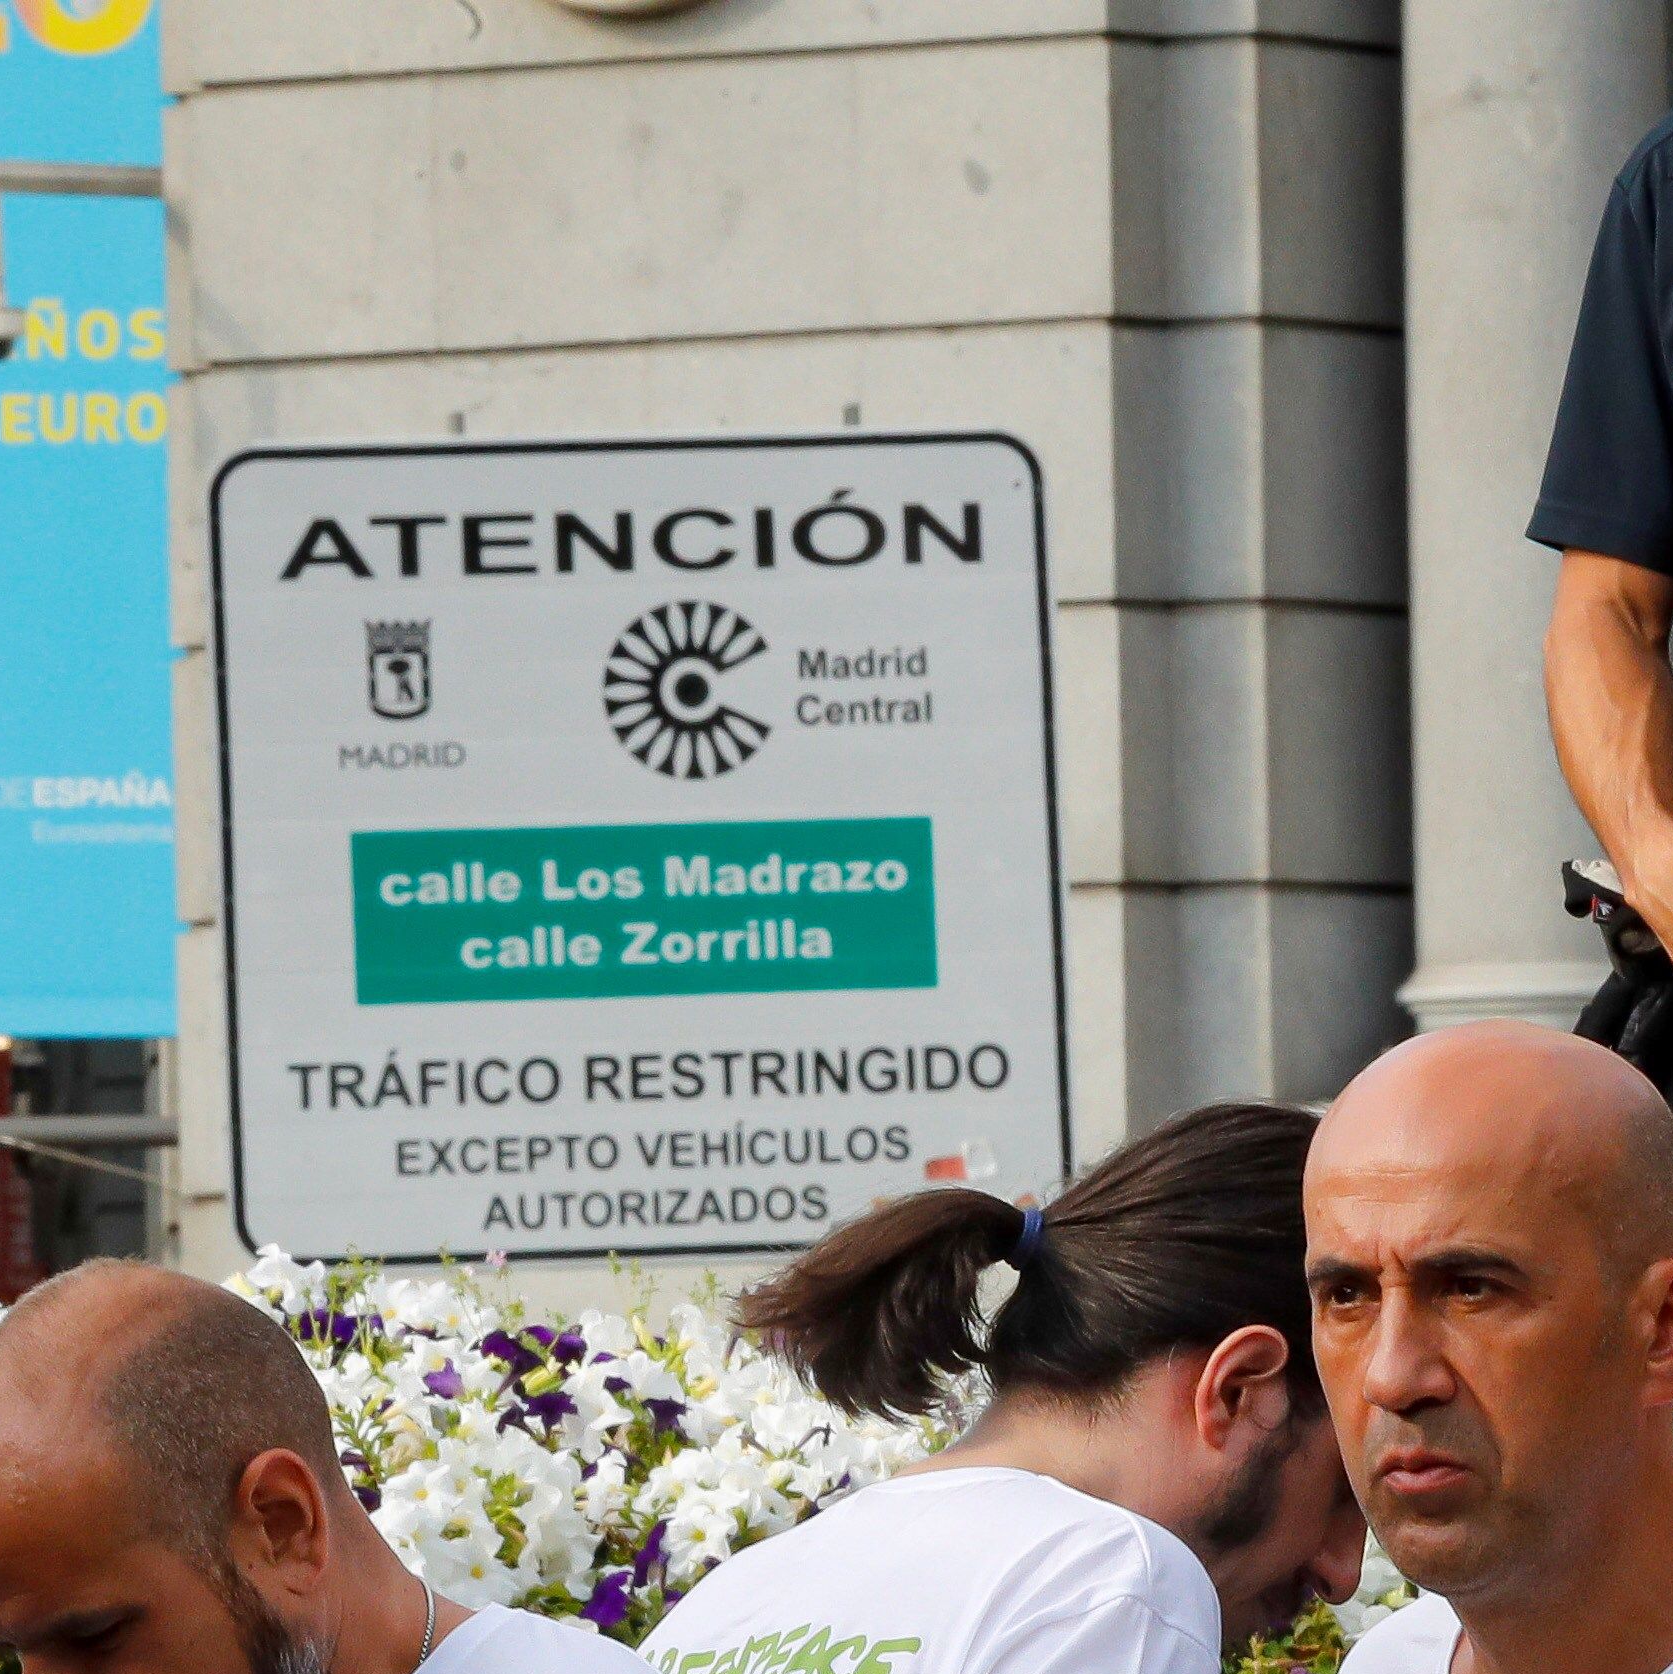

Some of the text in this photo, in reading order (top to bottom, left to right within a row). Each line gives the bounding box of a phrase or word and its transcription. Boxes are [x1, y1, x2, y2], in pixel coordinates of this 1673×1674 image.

[0, 391, 169, 444] EURO
[280, 487, 982, 580] ATENCIÓN
[797, 647, 928, 679] Madrid
[796, 692, 933, 727] Central
[338, 739, 467, 770] MADRID
[380, 853, 908, 905] calle Los Madrazo
[460, 918, 833, 969] calle Zorrilla
[288, 1043, 1009, 1109] TRÁFICO RESTRINGIDO
[395, 1120, 910, 1176] EXCEPTO VEHÍCULOS
[483, 1184, 828, 1231] AUTORIZADOS
